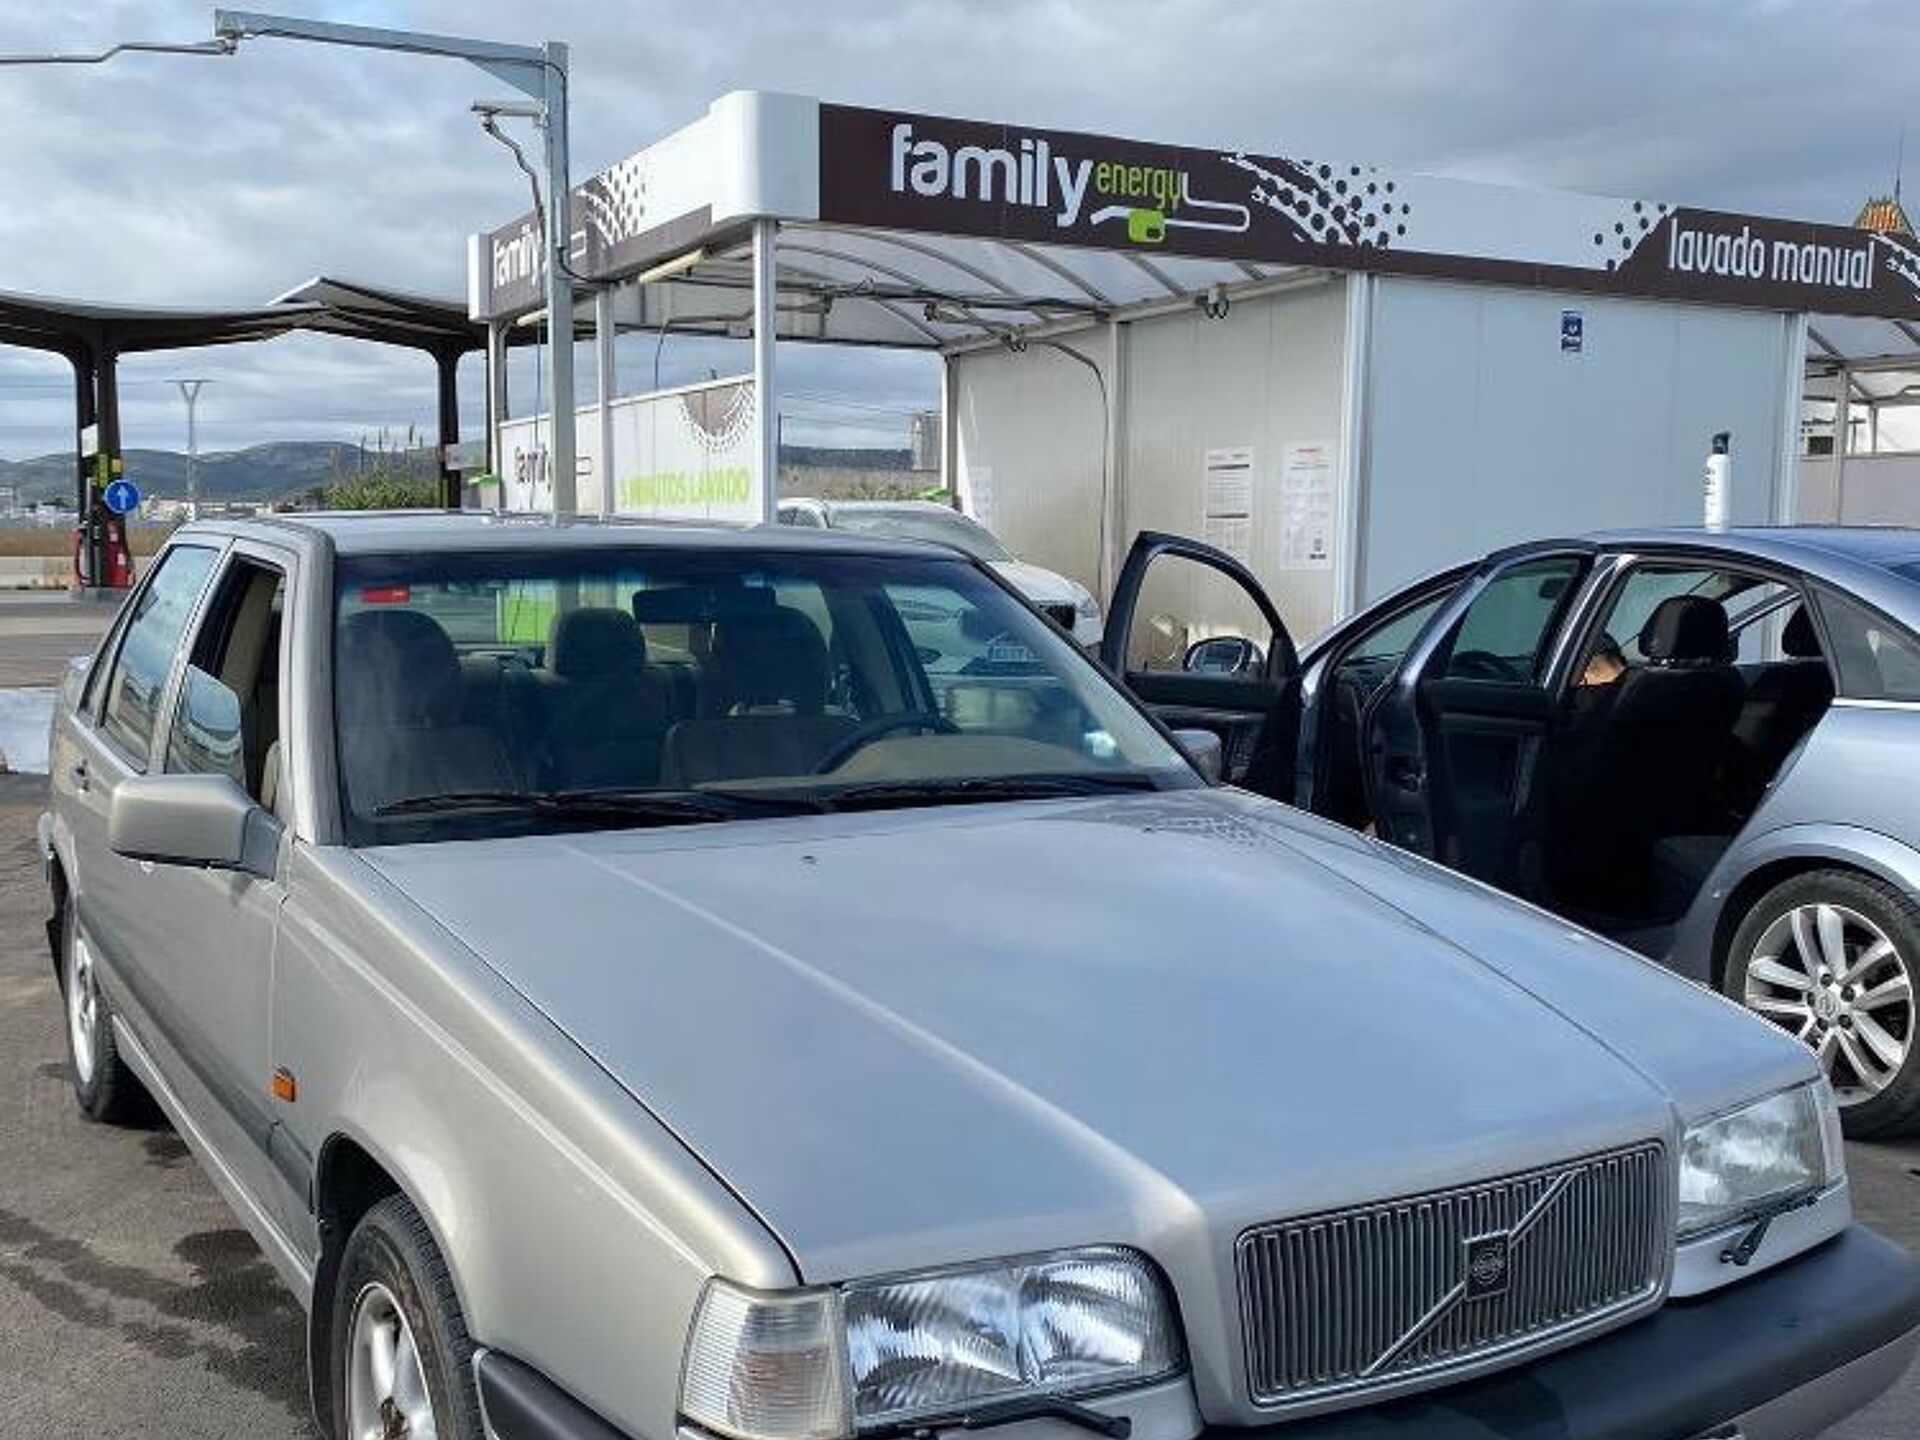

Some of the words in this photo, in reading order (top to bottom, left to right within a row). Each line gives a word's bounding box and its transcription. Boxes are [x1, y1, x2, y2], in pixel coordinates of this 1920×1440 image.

[891, 123, 1094, 228] family
[1095, 160, 1184, 210] energy
[1668, 218, 1765, 280] lavado
[1771, 240, 1875, 289] manual
[629, 472, 687, 507] UTOS
